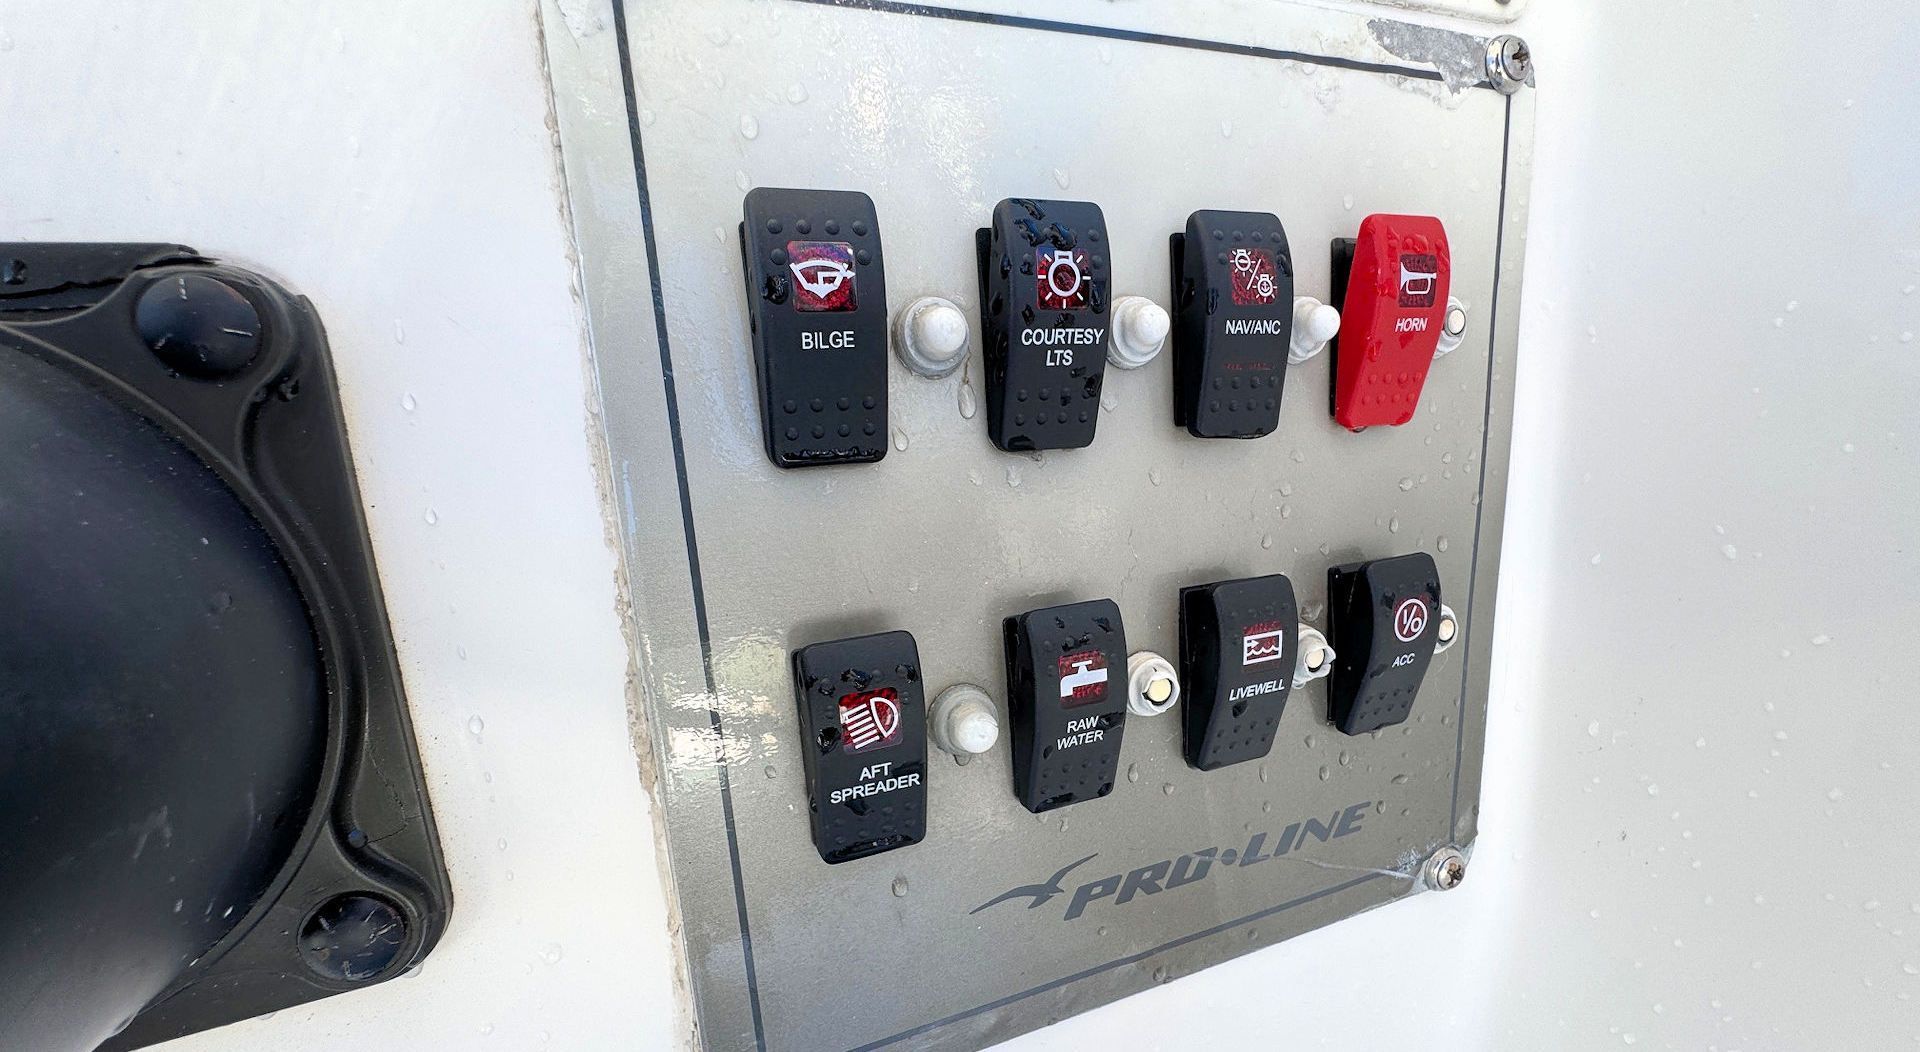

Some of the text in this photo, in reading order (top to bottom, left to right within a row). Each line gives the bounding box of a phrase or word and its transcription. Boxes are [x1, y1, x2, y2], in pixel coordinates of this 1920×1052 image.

[1225, 319, 1281, 335] NAV/ANC
[1394, 317, 1428, 333] HORN
[801, 331, 855, 350] BILGE
[1021, 328, 1104, 346] COURTESY
[1046, 349, 1073, 367] LTS
[1392, 652, 1415, 669] ACC
[1229, 678, 1285, 702] LIVEWELL
[1067, 715, 1100, 734] RAW
[1057, 729, 1104, 751] WATER
[859, 762, 892, 782] AFT
[830, 773, 920, 804] SPREADER
